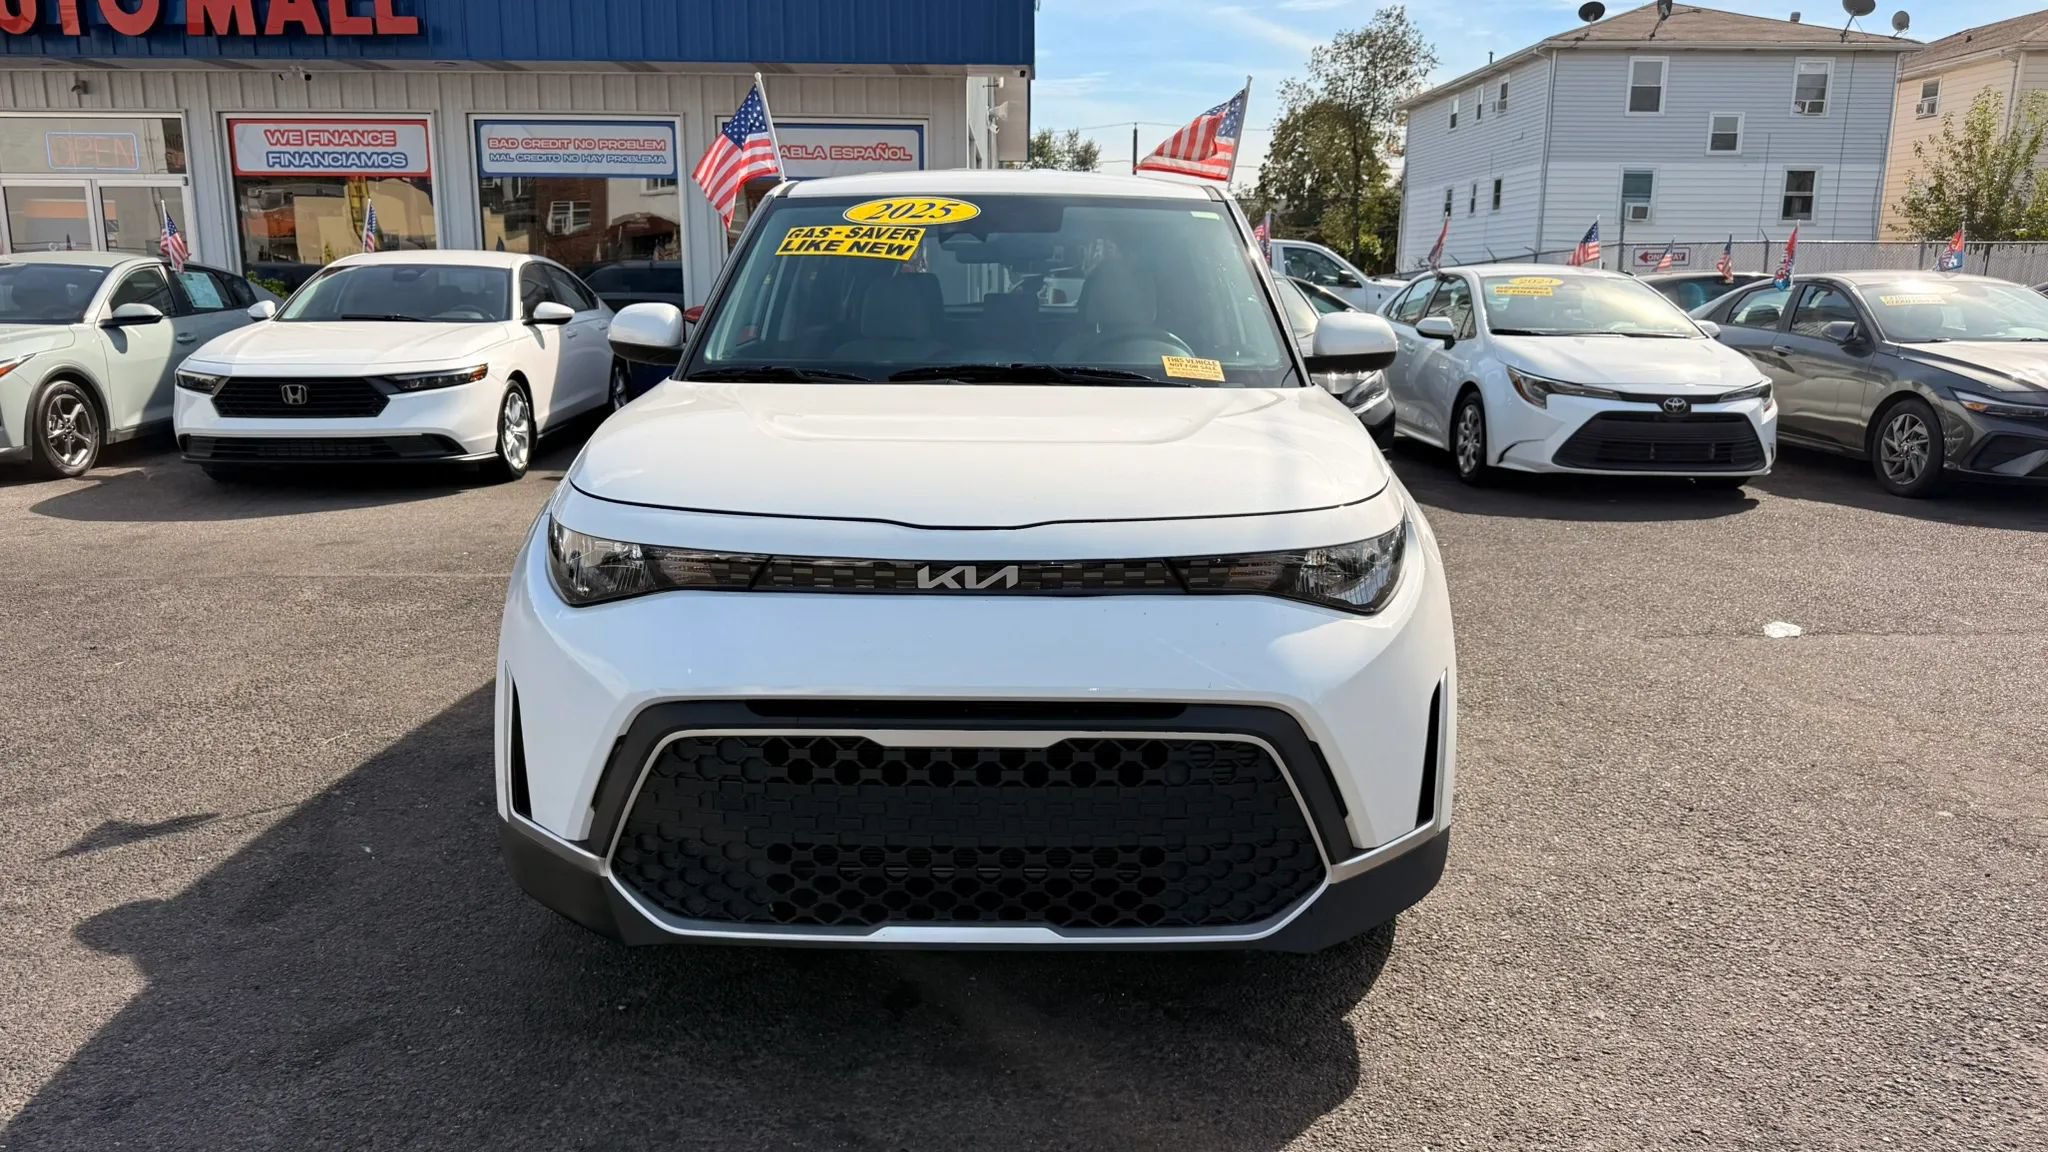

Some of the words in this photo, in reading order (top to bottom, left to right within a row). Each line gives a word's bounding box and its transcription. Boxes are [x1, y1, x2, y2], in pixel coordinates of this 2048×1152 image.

[187, 0, 419, 36] MALL
[264, 129, 303, 146] WE
[305, 130, 397, 147] FINANCE
[488, 138, 520, 150] BAD
[521, 138, 572, 150] CREDIT
[574, 139, 596, 151] NO
[598, 139, 667, 152] PROBLEM
[266, 151, 408, 169] FINANCIAMOS
[489, 153, 515, 162] MAL
[515, 153, 562, 163] CREDITO
[562, 153, 581, 163] NO
[581, 154, 605, 164] HAY
[606, 154, 667, 165] PROBLEMA
[829, 142, 913, 161] ESPAÑOL
[863, 202, 960, 220] 2025
[844, 227, 922, 241] SAVER
[778, 239, 845, 253] LIKE
[848, 240, 915, 257] NEW
[917, 565, 1018, 589] KIA
